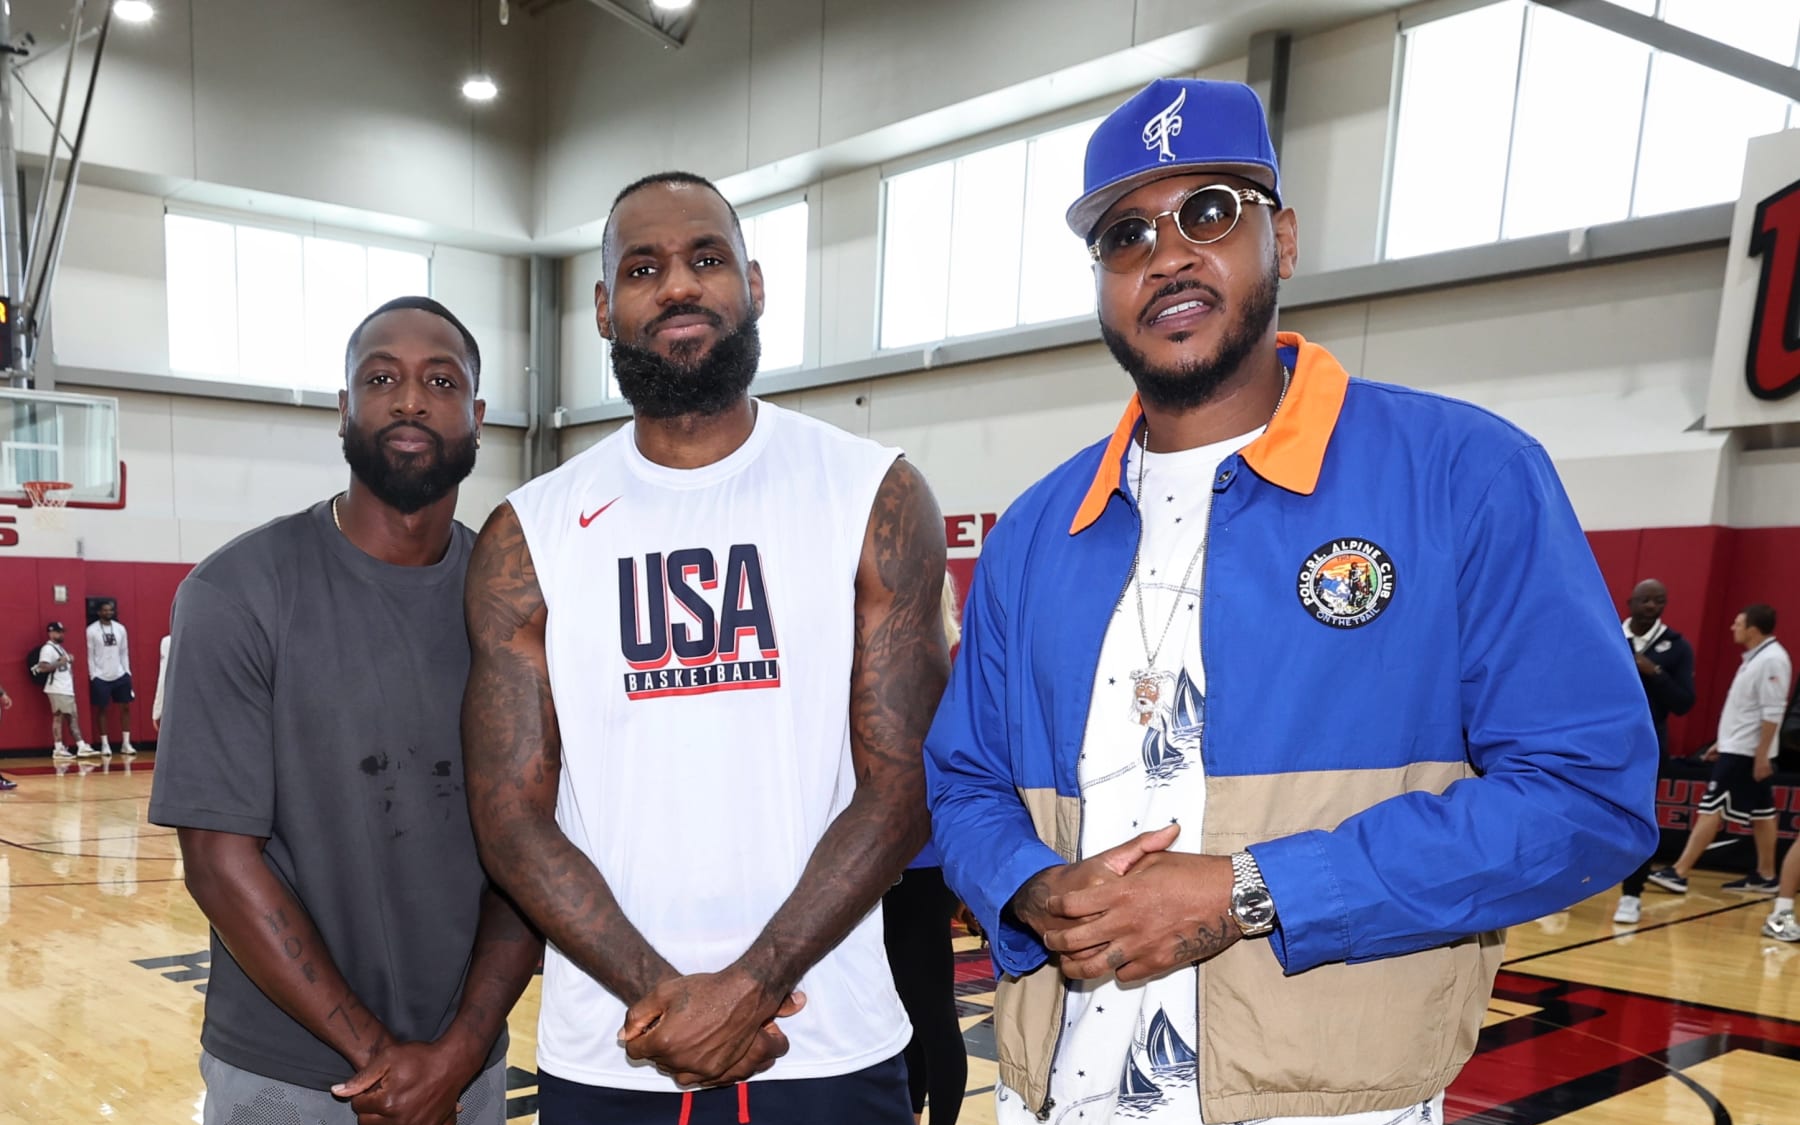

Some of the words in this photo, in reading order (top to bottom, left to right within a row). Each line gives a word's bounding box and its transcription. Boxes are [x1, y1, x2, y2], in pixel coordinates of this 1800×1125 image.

[1332, 540, 1381, 559] ALPINE
[1380, 562, 1393, 599] CLUB
[618, 543, 780, 671] USA
[1316, 610, 1331, 622] ON
[1331, 616, 1352, 626] THE
[1352, 607, 1380, 624] TRAIL
[627, 661, 774, 692] BASKETBALL
